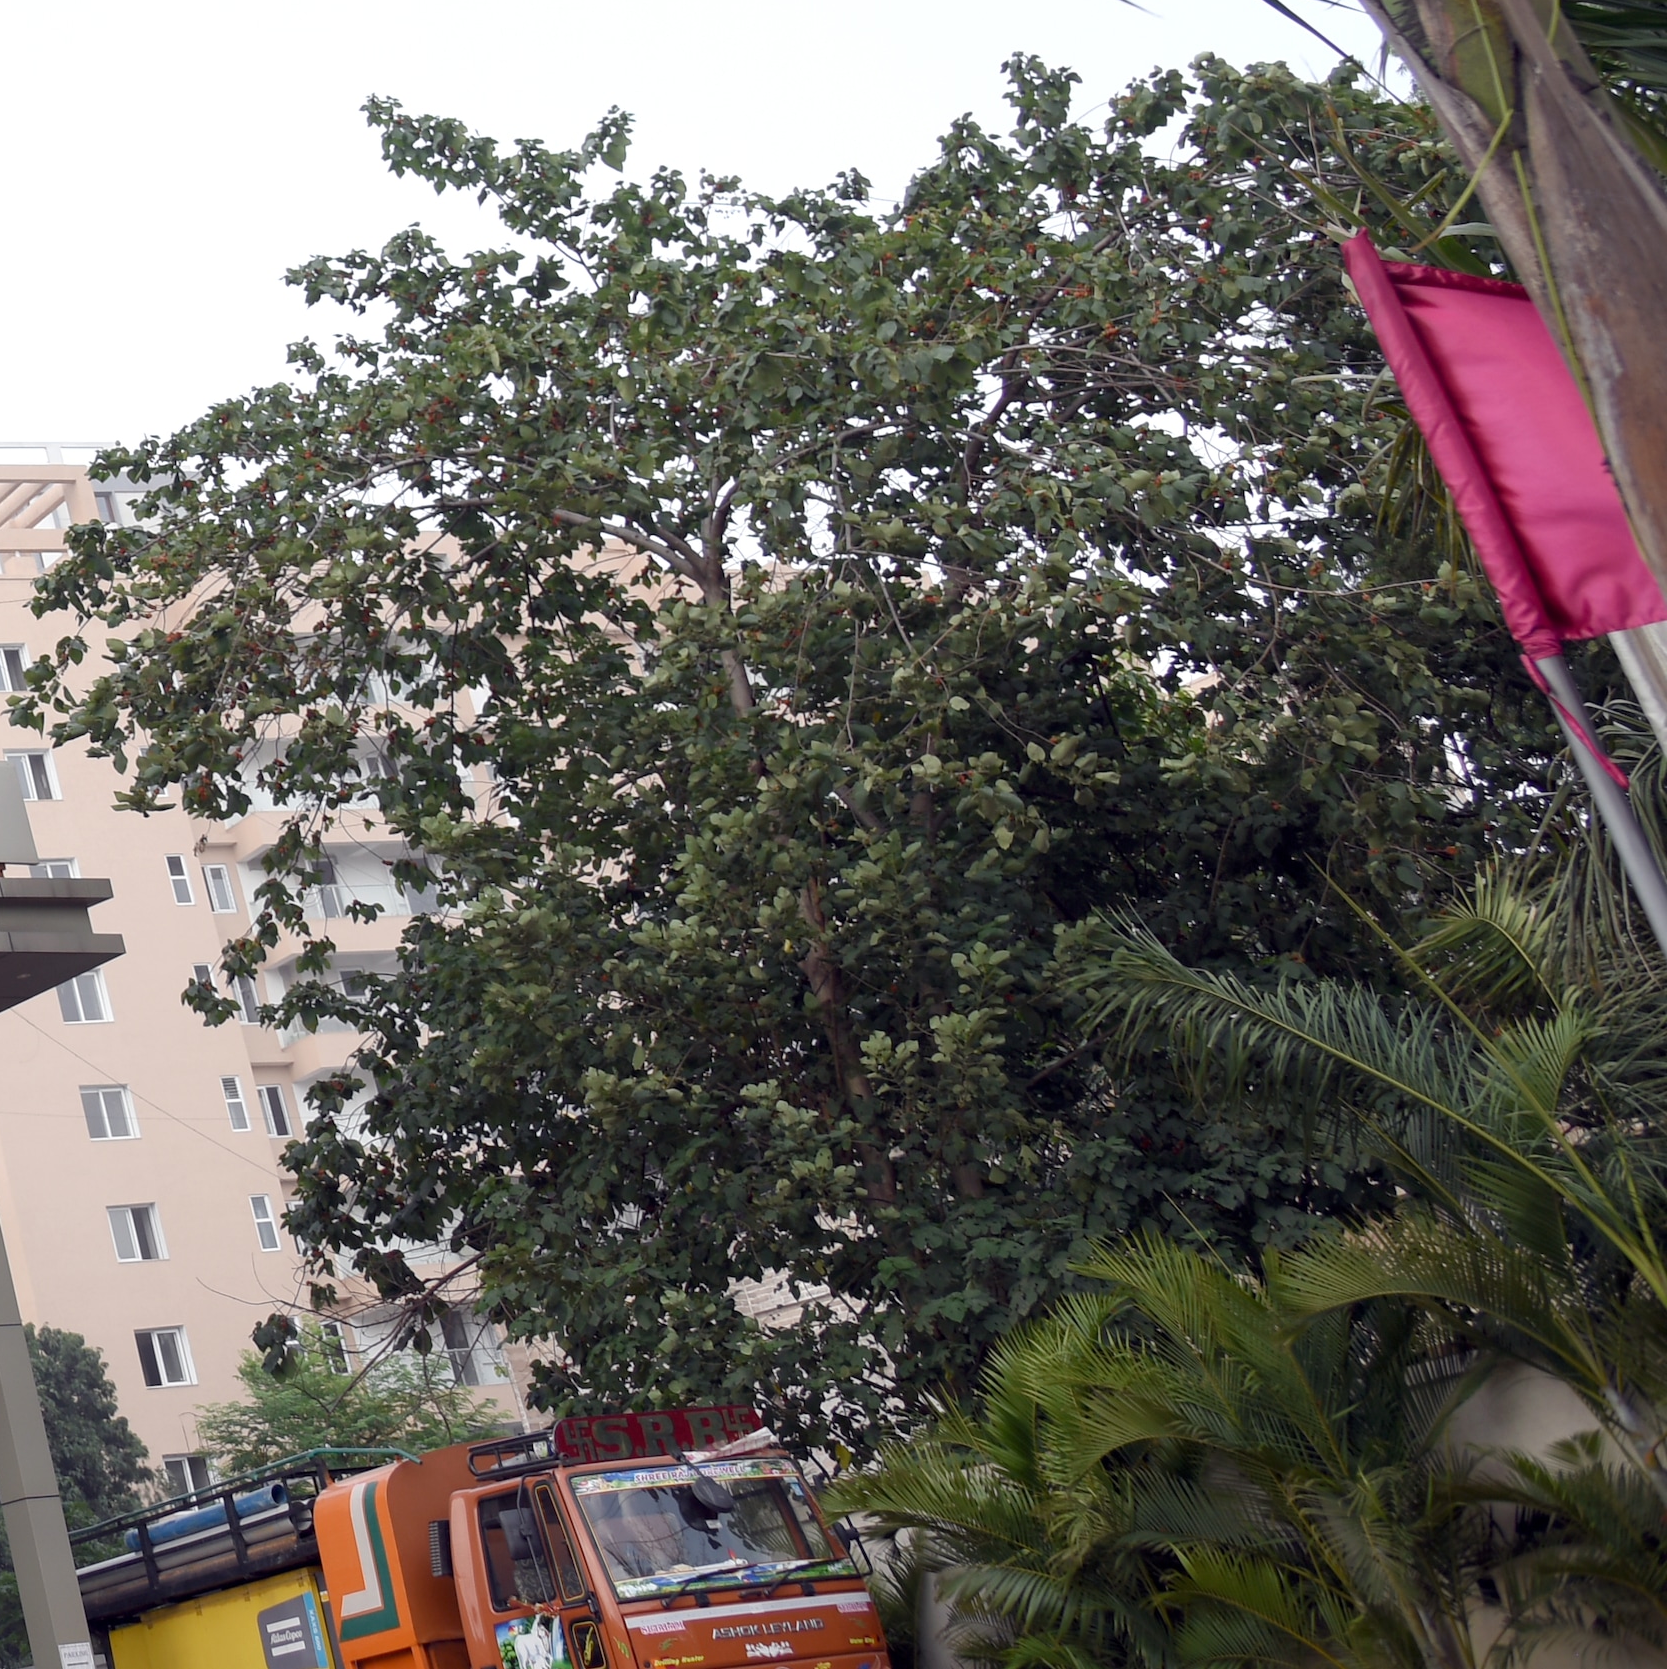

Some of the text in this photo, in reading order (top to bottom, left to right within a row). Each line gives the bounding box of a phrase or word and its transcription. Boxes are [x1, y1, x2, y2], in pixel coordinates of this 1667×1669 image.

[635, 1472, 668, 1483] SHREE
[712, 1618, 824, 1640] ASHOK LEYLAND
